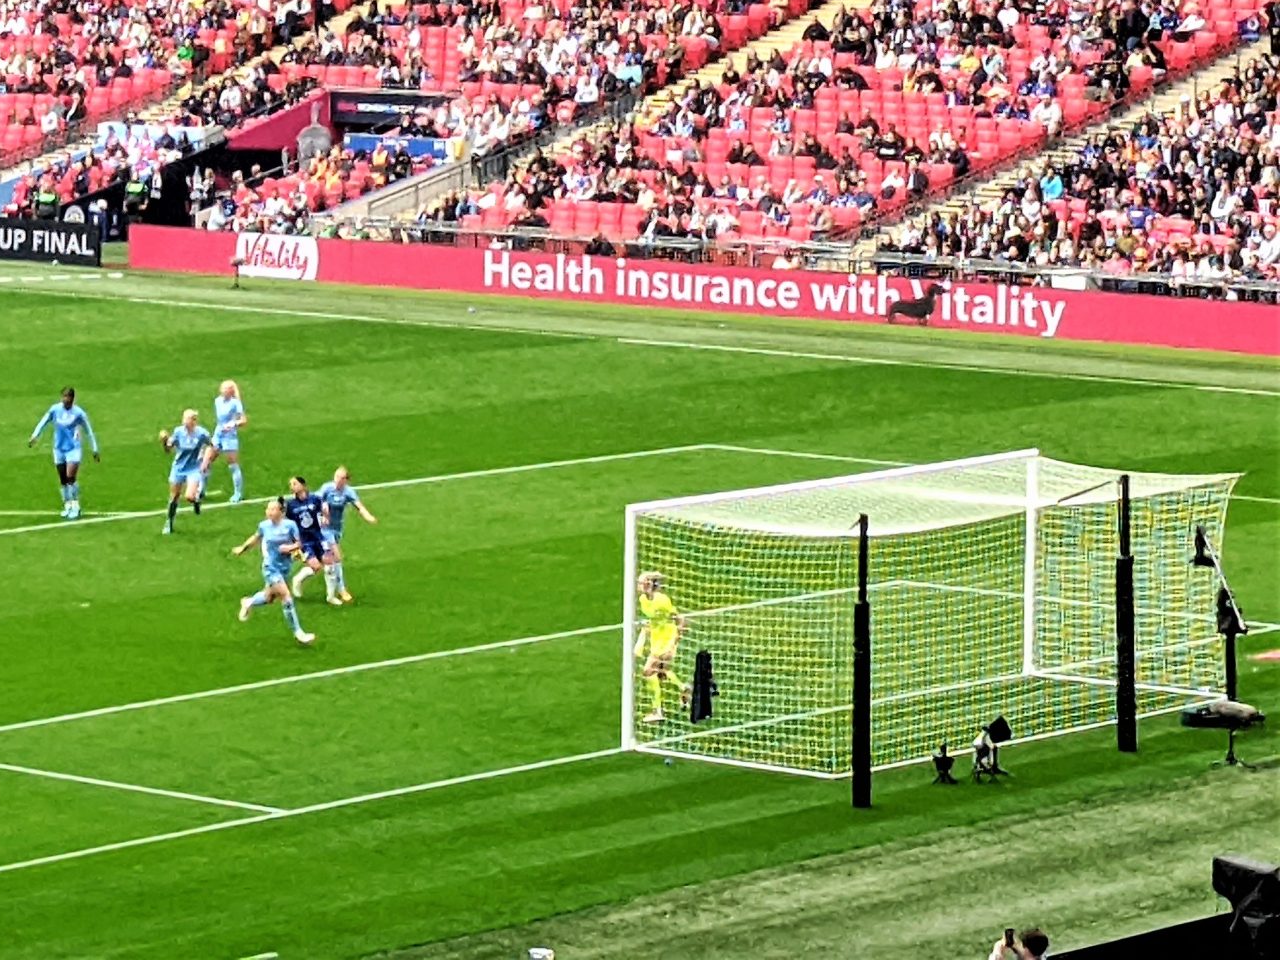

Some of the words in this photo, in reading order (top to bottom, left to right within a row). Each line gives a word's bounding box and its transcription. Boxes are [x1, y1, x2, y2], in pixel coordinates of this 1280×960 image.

[32, 230, 95, 256] FINAL
[243, 233, 309, 280] Vitality
[484, 249, 604, 294] Health
[616, 258, 801, 310] insurance
[810, 274, 900, 316] with
